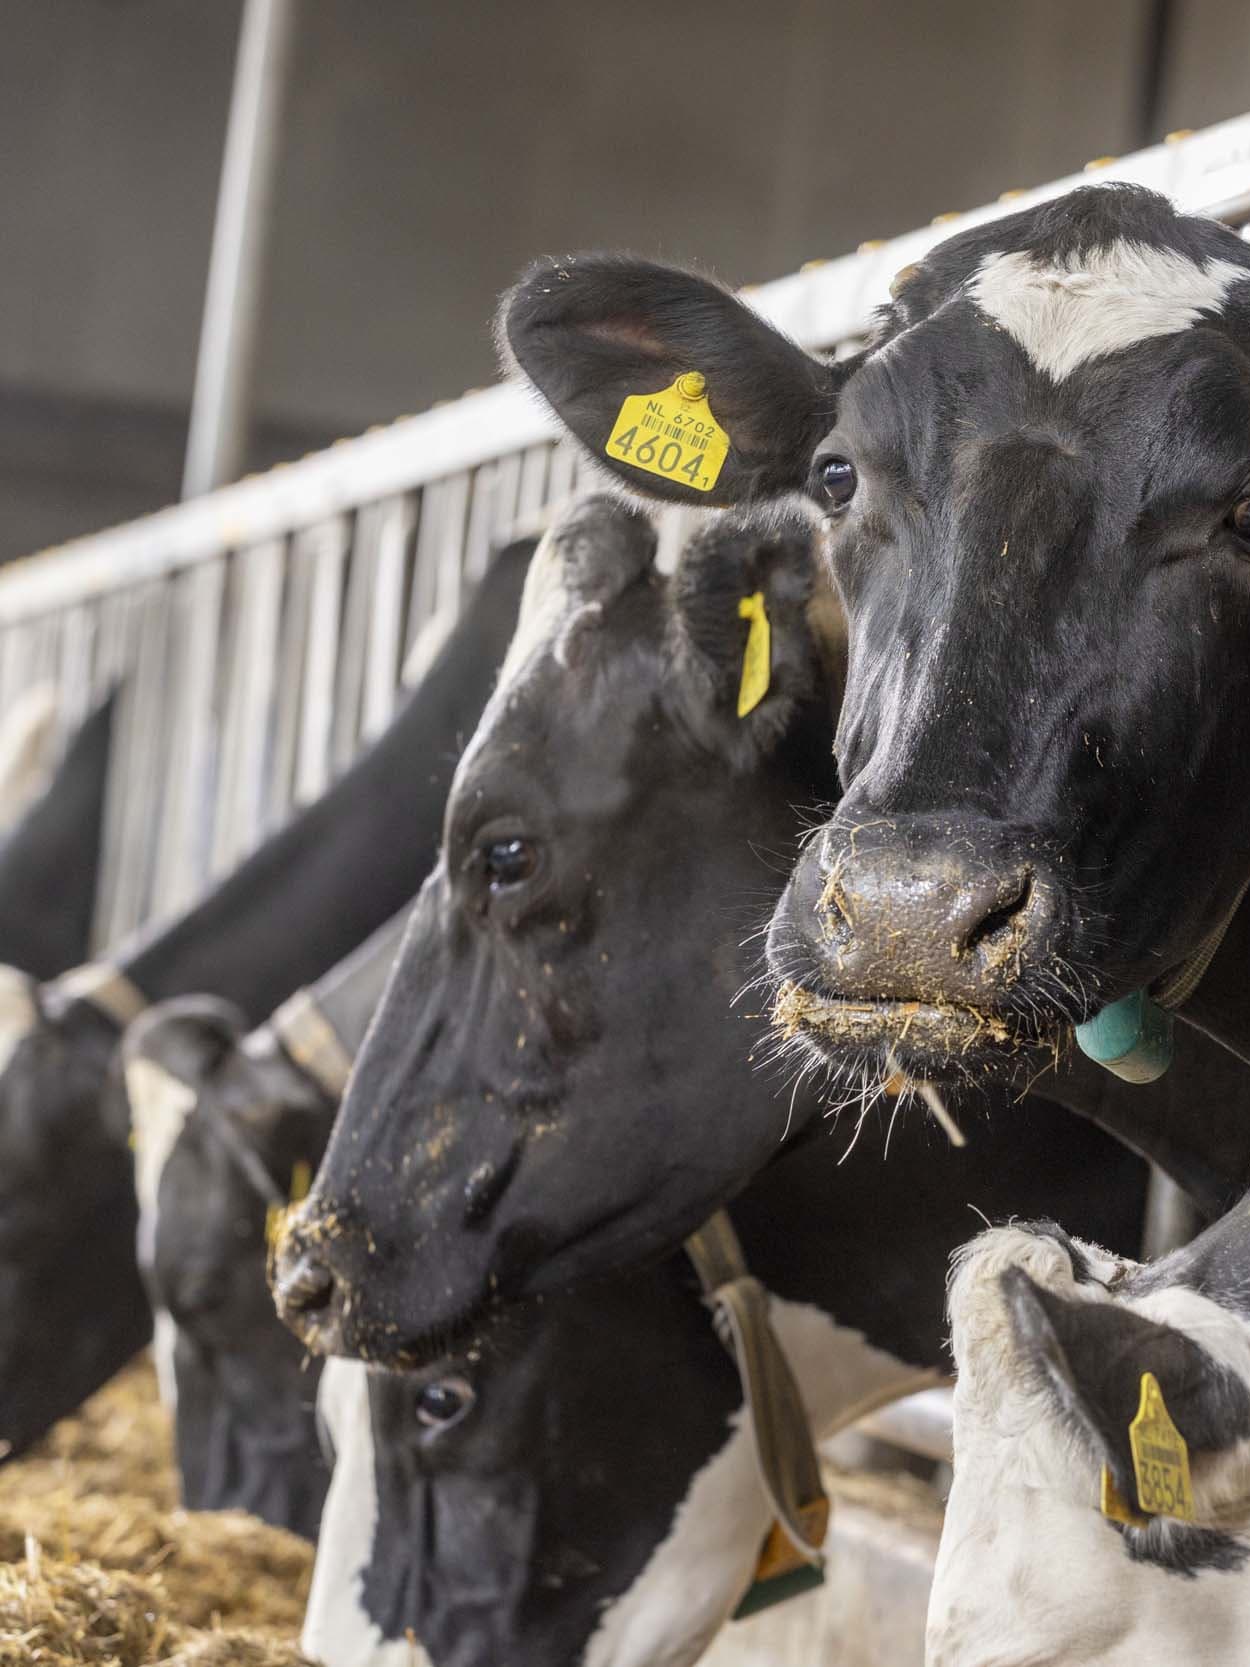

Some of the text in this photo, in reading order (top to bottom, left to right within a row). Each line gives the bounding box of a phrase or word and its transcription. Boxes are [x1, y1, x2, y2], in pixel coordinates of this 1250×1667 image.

[646, 400, 666, 418] NL
[673, 413, 715, 439] 6702
[614, 425, 705, 482] 4604
